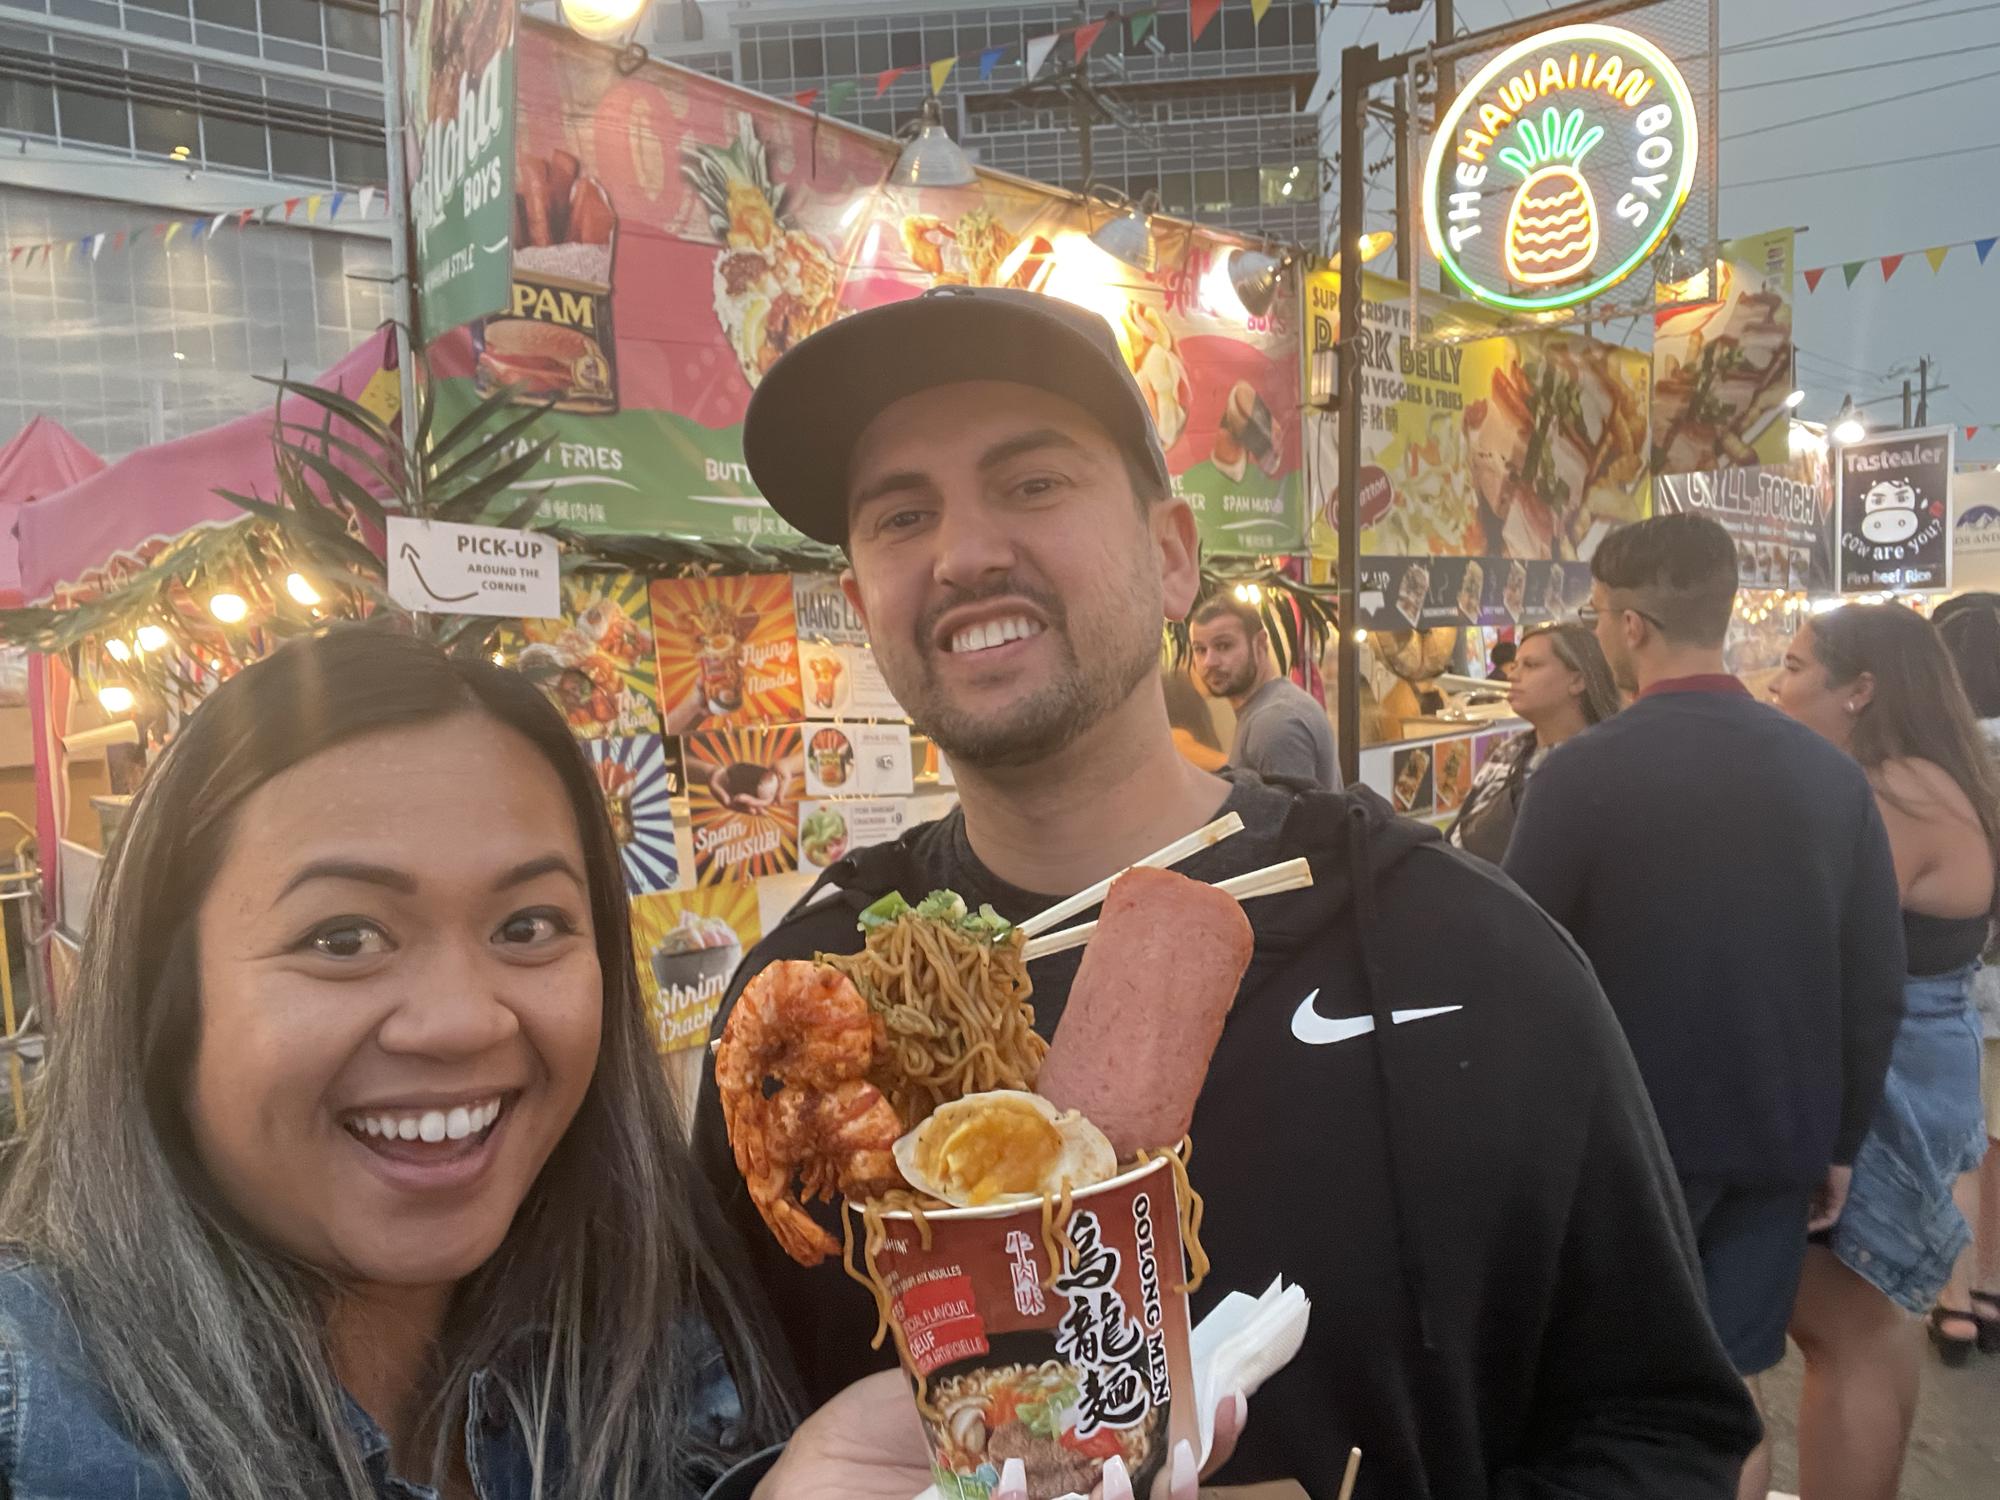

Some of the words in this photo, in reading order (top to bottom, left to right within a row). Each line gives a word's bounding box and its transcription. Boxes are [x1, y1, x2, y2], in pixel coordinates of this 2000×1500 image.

[1456, 53, 1656, 162] HAWAIIAN
[1615, 103, 1673, 228] BOYS
[463, 155, 501, 218] BOYS
[1448, 162, 1489, 252] THE
[500, 283, 594, 328] PAM
[1361, 301, 1400, 328] RISPY
[1436, 389, 1464, 413] FRIES
[559, 442, 623, 472] FRIES
[1758, 471, 1816, 526] TORCH
[457, 535, 543, 559] PICK-UP
[1872, 544, 1905, 562] are
[1907, 518, 1944, 555] you?
[467, 564, 516, 576] AROUND
[520, 567, 539, 579] THE
[482, 581, 527, 593] CORNER
[796, 590, 840, 630] HANG
[696, 822, 747, 853] Spam
[923, 1300, 970, 1324] FLAVOUR
[1132, 1193, 1161, 1328] OOLONG
[1148, 1328, 1171, 1405] MEN
